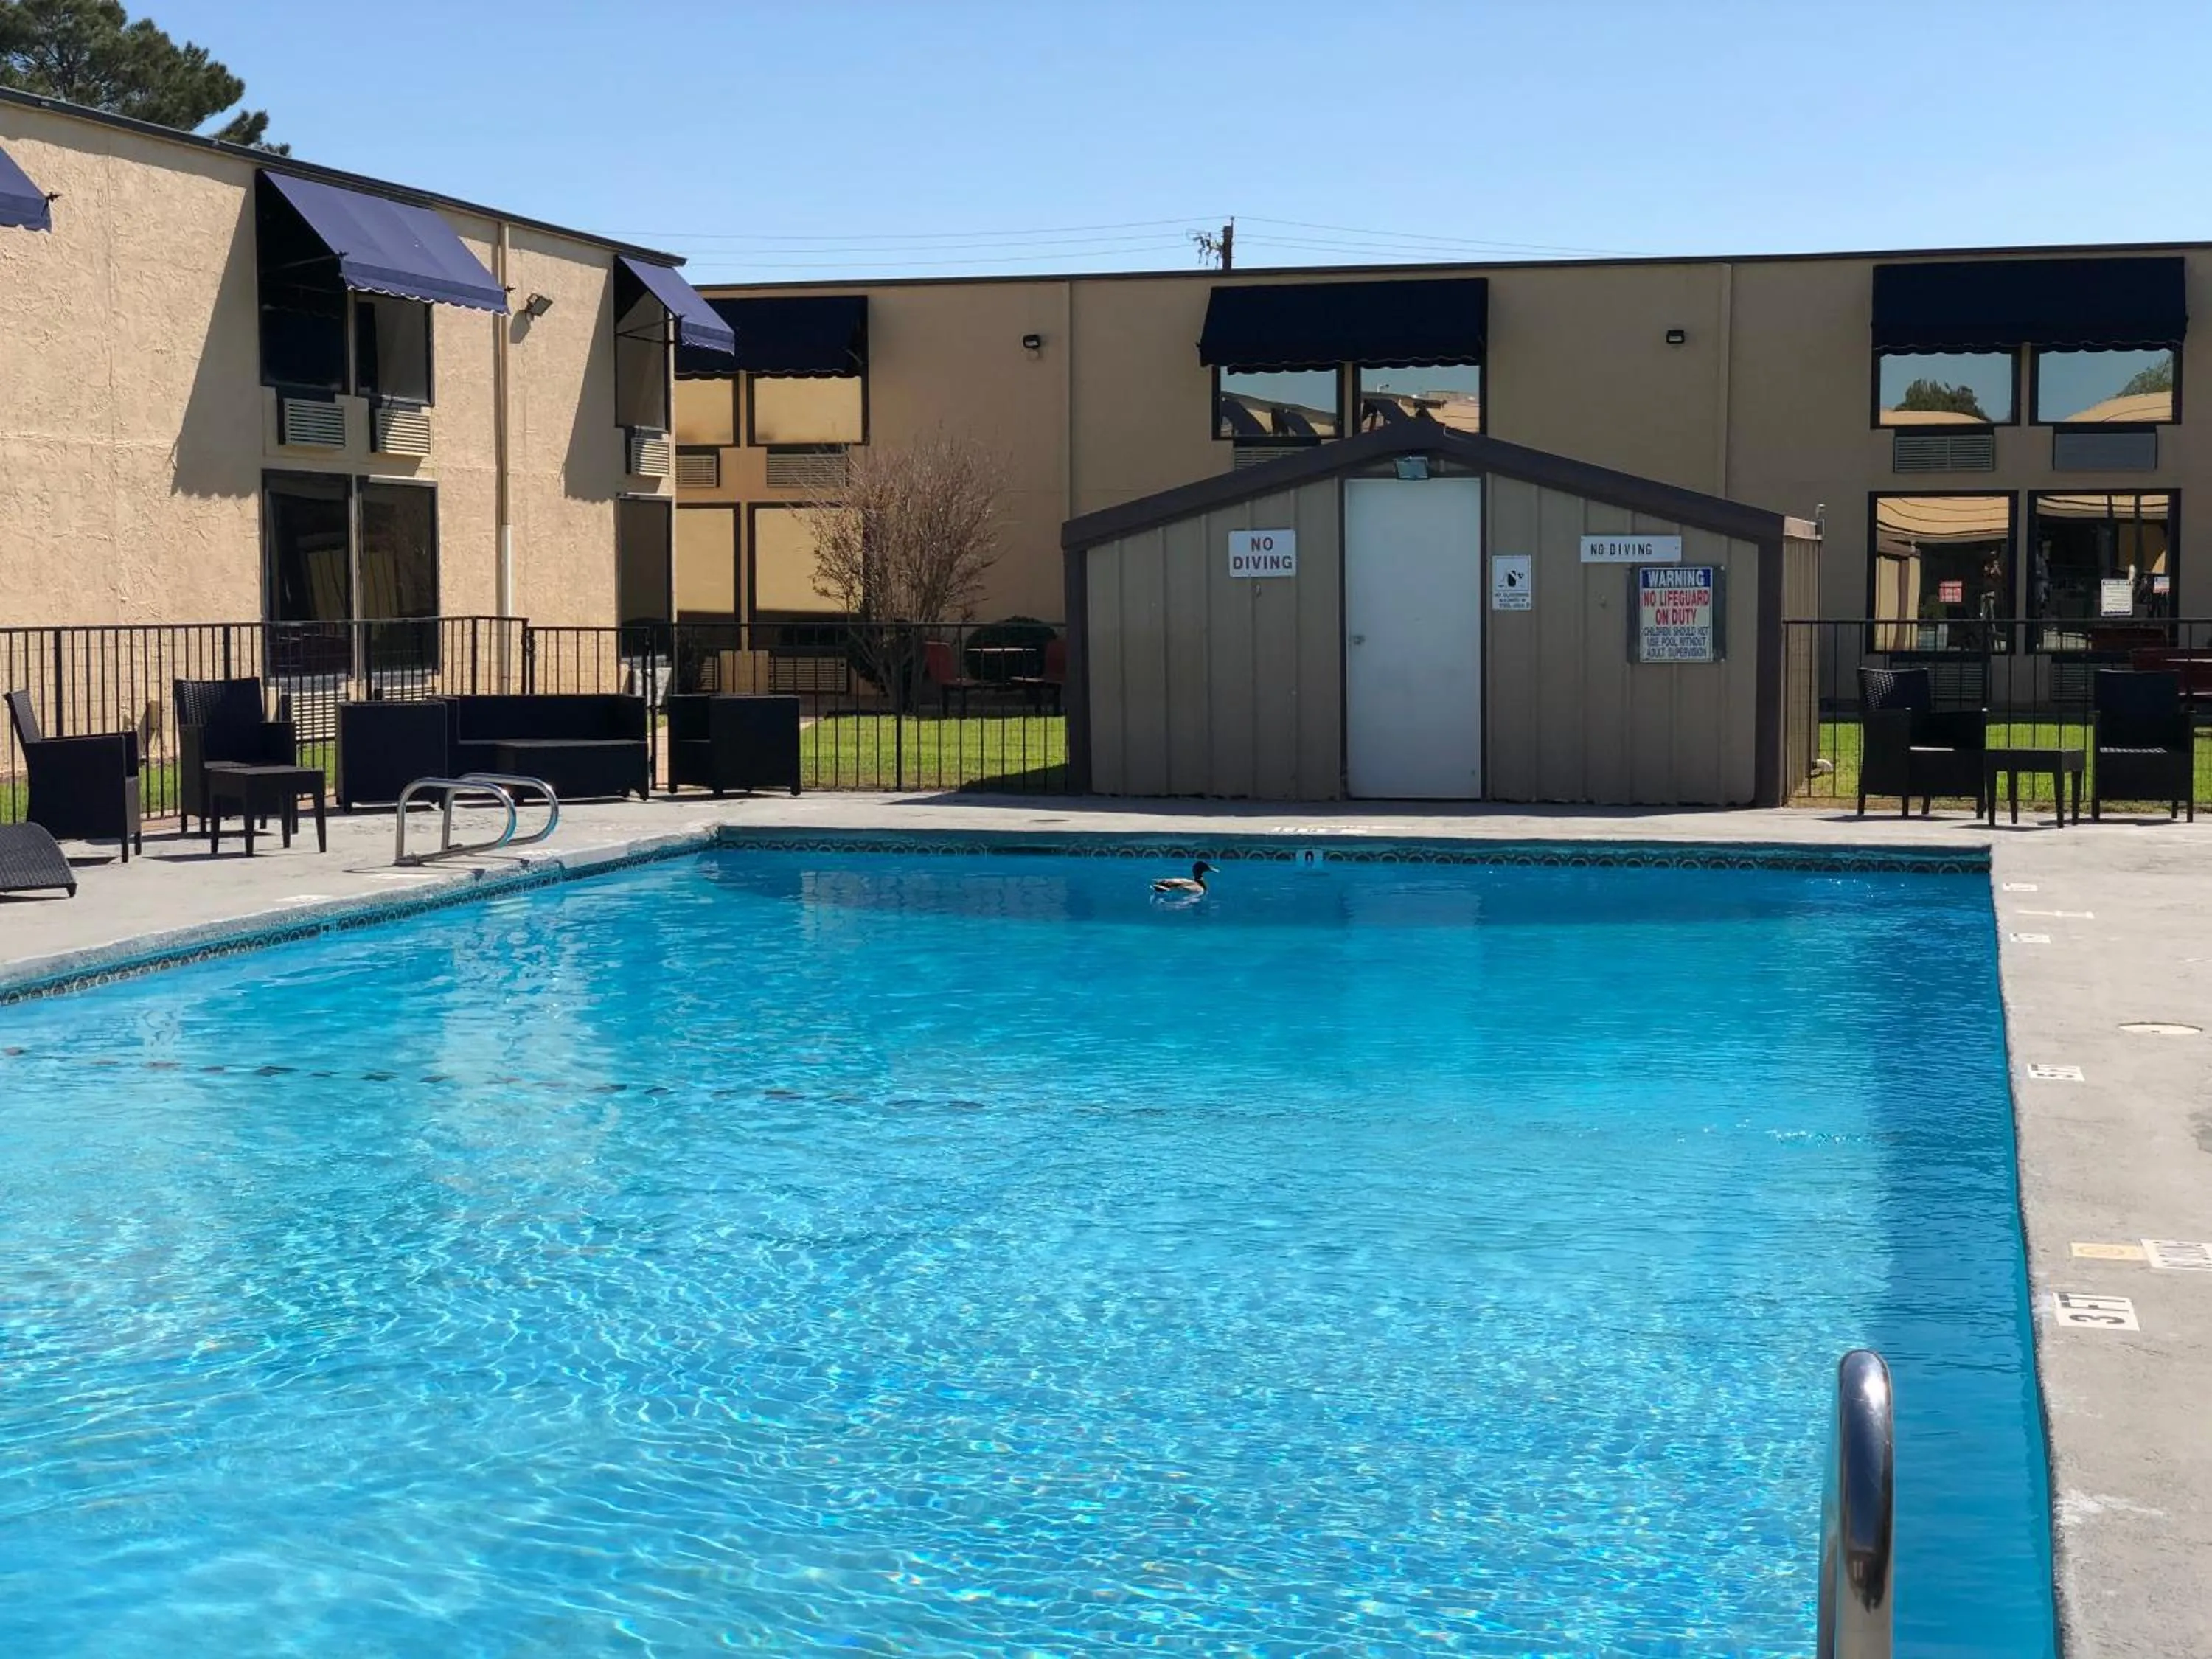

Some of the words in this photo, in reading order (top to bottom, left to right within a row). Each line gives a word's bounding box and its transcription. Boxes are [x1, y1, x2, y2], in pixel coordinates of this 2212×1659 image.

[1251, 537, 1273, 551] NO
[1590, 543, 1604, 555] NO
[1610, 543, 1652, 555] DIVING
[1233, 556, 1293, 569] DIVING
[1648, 570, 1704, 587] WARNING
[1644, 590, 1656, 607] NO
[1660, 589, 1709, 606] LIFEGUARD
[1656, 608, 1669, 625] ON
[1672, 608, 1697, 625] DUTY
[2068, 1315, 2125, 1324] 3
